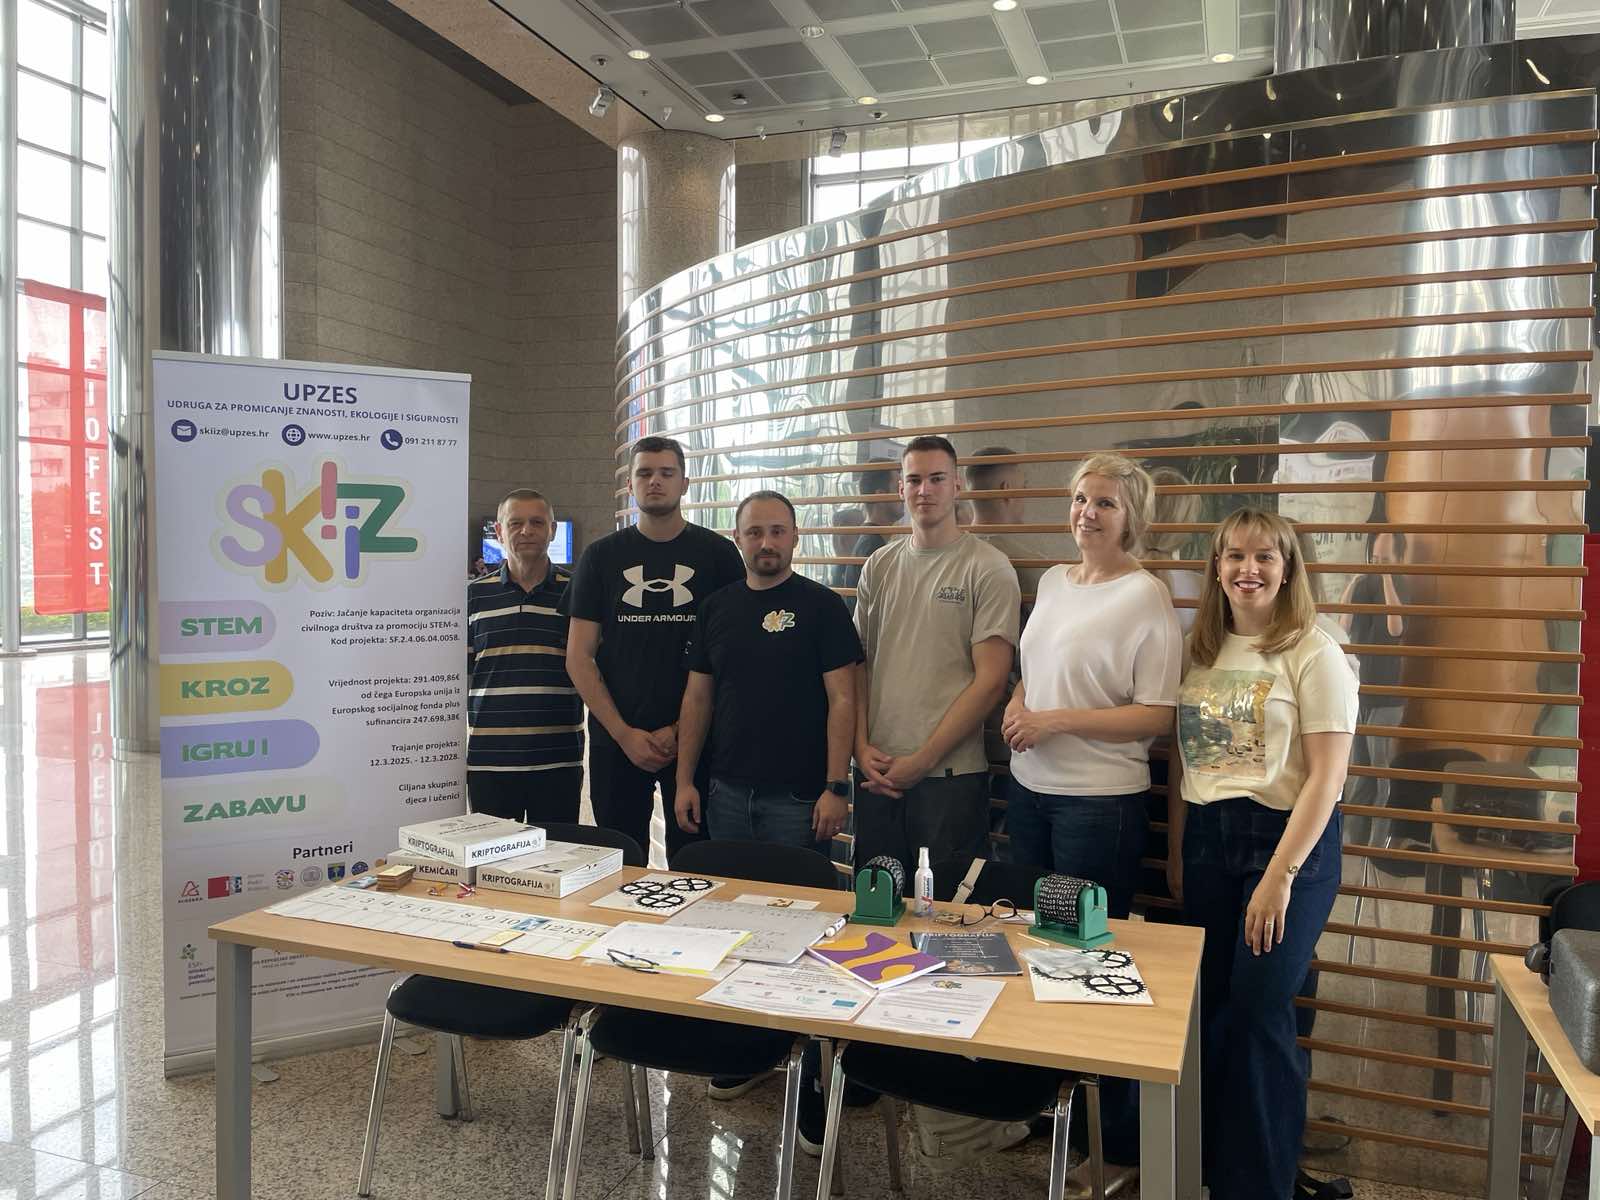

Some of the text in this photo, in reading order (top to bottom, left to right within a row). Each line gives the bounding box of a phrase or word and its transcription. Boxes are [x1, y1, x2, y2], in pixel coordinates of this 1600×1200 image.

[283, 382, 358, 404] UPZES
[167, 400, 213, 411] UDRUGA
[214, 402, 228, 411] ZA
[230, 404, 293, 416] PROMICANJE
[295, 407, 348, 418] ZNANOSTI,
[350, 410, 399, 421] EKOLOGIJE
[406, 413, 459, 424] SIGURNOSTI
[199, 426, 270, 438] skiiz@upzes.hr
[308, 432, 371, 442] www.upzes.hr
[404, 436, 419, 445] 091
[421, 437, 435, 446] 211
[309, 607, 461, 619] Poziv: Jačanje kapaciteta organizacija
[617, 614, 697, 622] UNDER ARMOUR
[180, 616, 264, 638] STEM
[301, 624, 340, 634] civilnoga
[341, 622, 373, 631] društva
[385, 621, 428, 631] promociju
[330, 637, 348, 645] Kod
[349, 636, 388, 646] projekta:
[181, 676, 270, 699] KROZ
[328, 678, 372, 688] Vrijednost
[373, 676, 412, 686] projekta:
[360, 690, 372, 699] od
[373, 691, 393, 700] čega
[394, 689, 432, 699] Europska
[433, 687, 453, 697] unija
[331, 700, 461, 715] Europskog socijalnog fonda plus
[365, 717, 411, 727] sufinancira
[181, 738, 269, 763] IGRU I
[391, 740, 460, 752] Trajanje projekta:
[370, 757, 413, 767] 12.3.2025.
[420, 753, 460, 764] 12.3.2028.
[398, 779, 460, 793] Ciljana skupina:
[405, 795, 427, 805] djeca
[183, 794, 307, 823] ZABAVU
[292, 841, 354, 860] Partneri
[407, 836, 455, 859] KRIPTOGRAFIJA
[471, 840, 531, 859] KRIPTOGRAFIJA
[418, 864, 458, 877] KEMIČARI
[481, 873, 543, 889] KRIPTOGRAFIJA
[500, 917, 521, 925] 10
[543, 923, 564, 932] 12
[564, 926, 584, 935] 13
